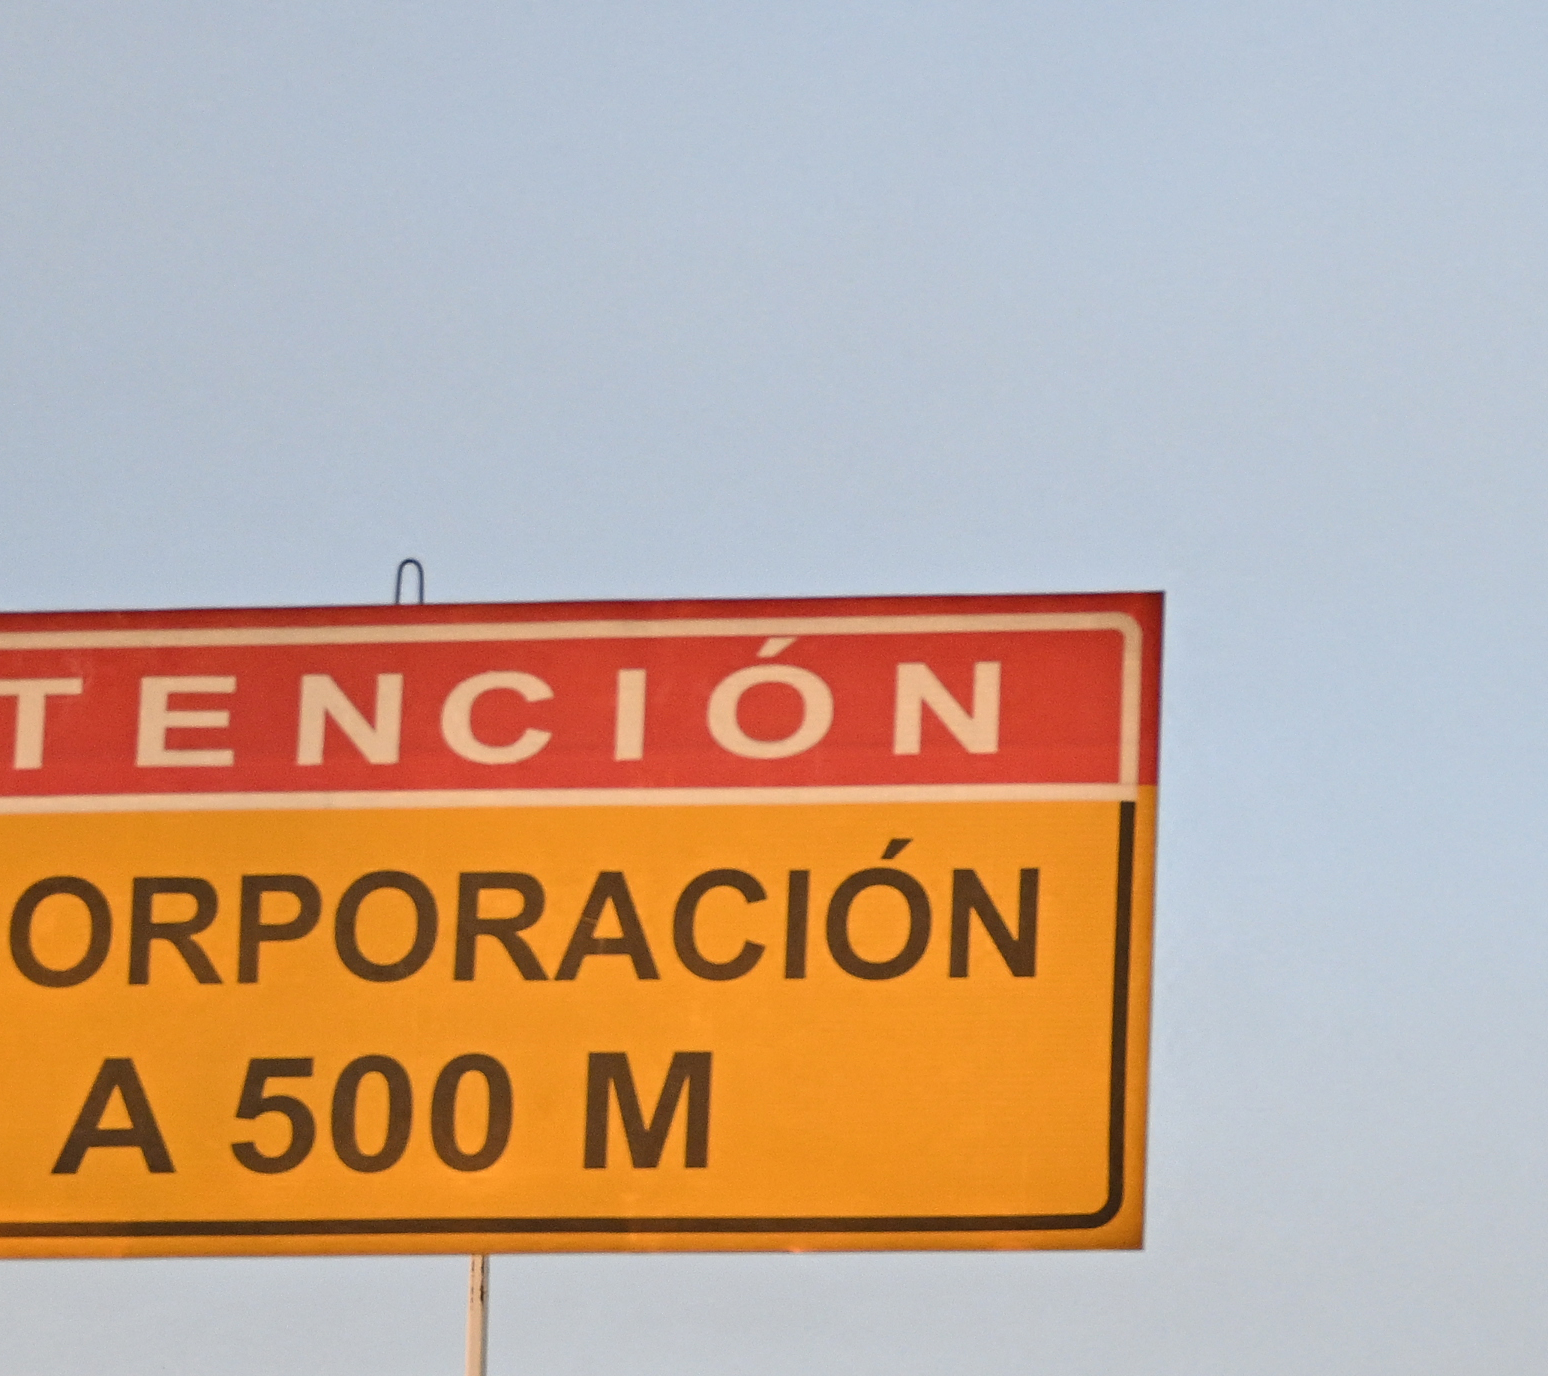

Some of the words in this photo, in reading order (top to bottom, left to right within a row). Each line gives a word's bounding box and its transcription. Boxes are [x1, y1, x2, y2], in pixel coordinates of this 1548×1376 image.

[49, 1057, 178, 1175] A
[228, 1053, 514, 1174] 500
[581, 1051, 714, 1170] M
